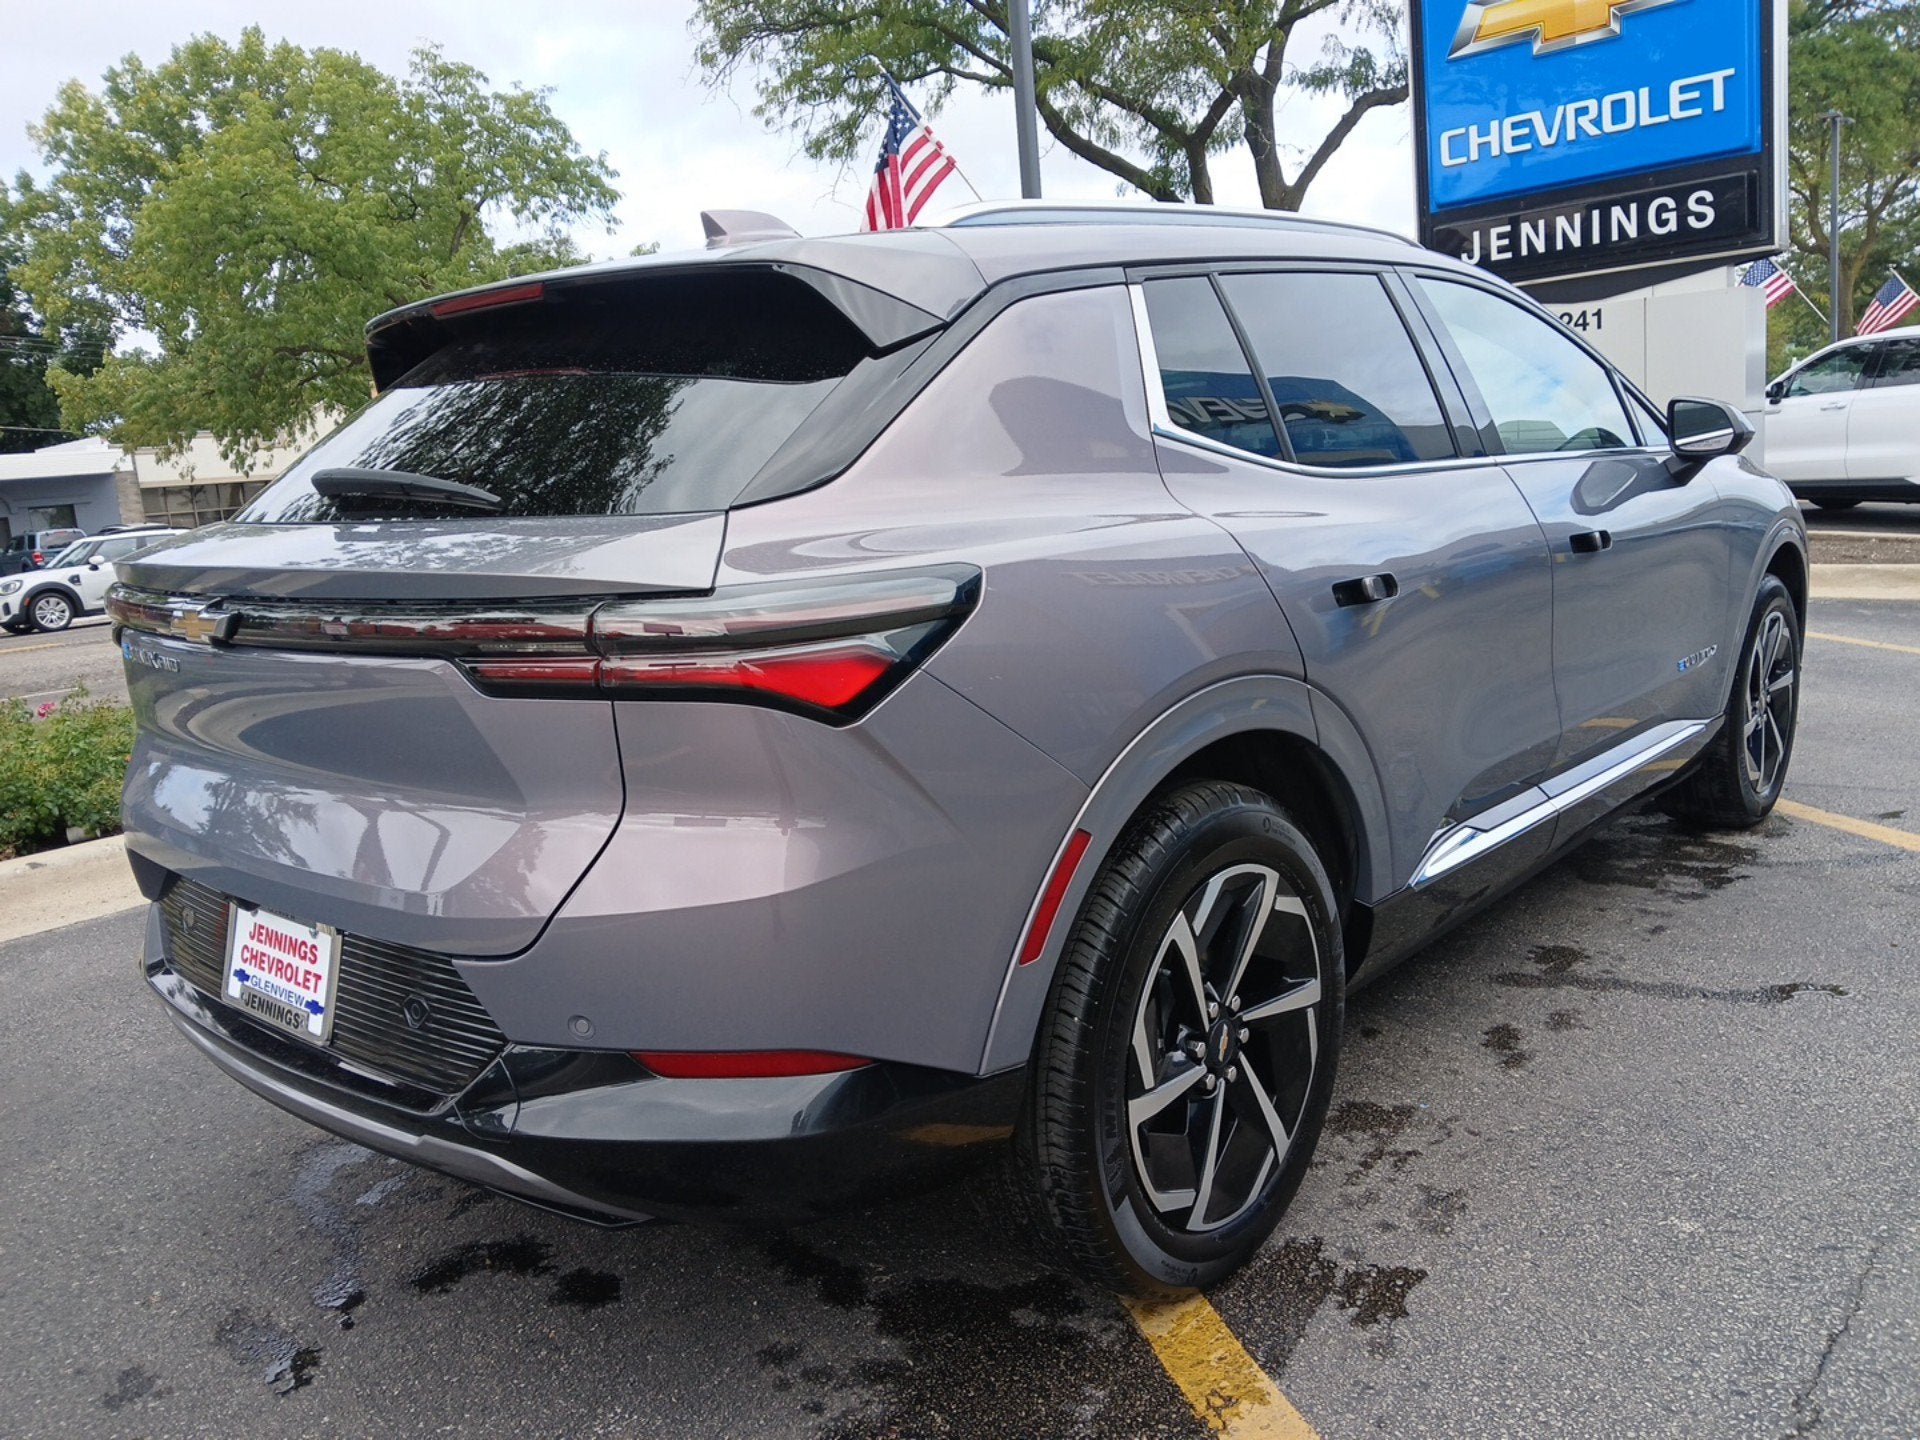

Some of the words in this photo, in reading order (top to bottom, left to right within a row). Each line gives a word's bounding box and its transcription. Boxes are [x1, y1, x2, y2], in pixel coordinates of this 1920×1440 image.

[1440, 67, 1736, 167] CHEVROLET
[1461, 189, 1716, 266] JENNINGS
[249, 922, 319, 965] JENNINGS
[240, 944, 322, 994] CHEVROLET
[250, 974, 306, 1008] GLENVIEW
[244, 993, 301, 1030] JENNINGS
